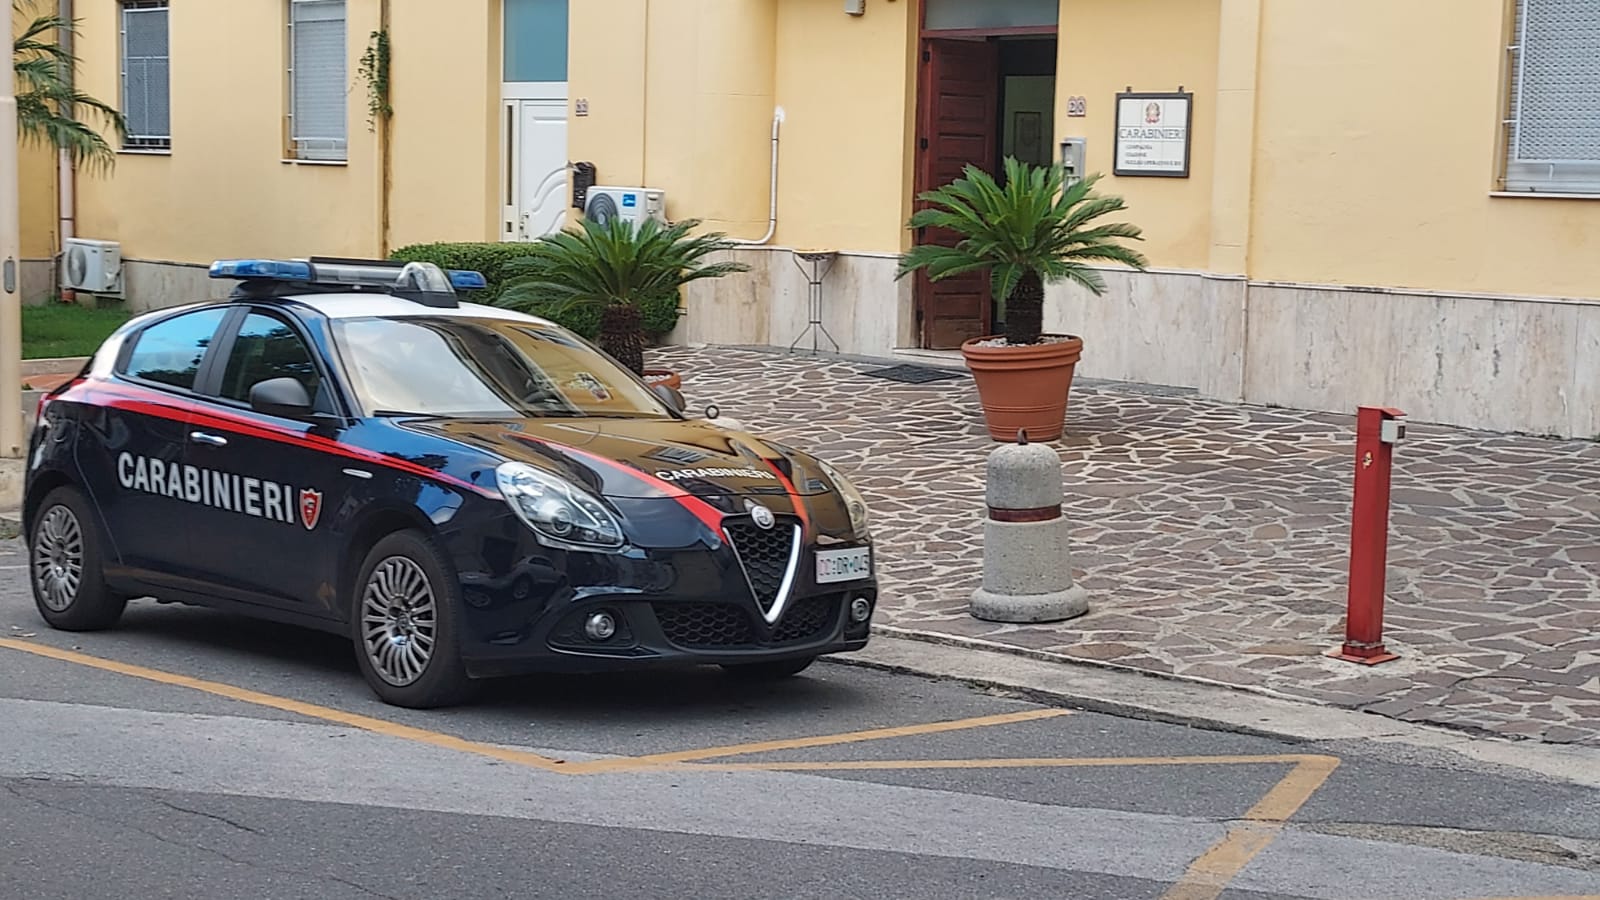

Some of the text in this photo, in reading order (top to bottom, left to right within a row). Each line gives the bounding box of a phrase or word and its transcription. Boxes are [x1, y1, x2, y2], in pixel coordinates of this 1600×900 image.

[1120, 128, 1185, 139] CARABINIERI
[655, 467, 776, 481] CARABINIERI
[118, 451, 295, 524] CARABINIERI
